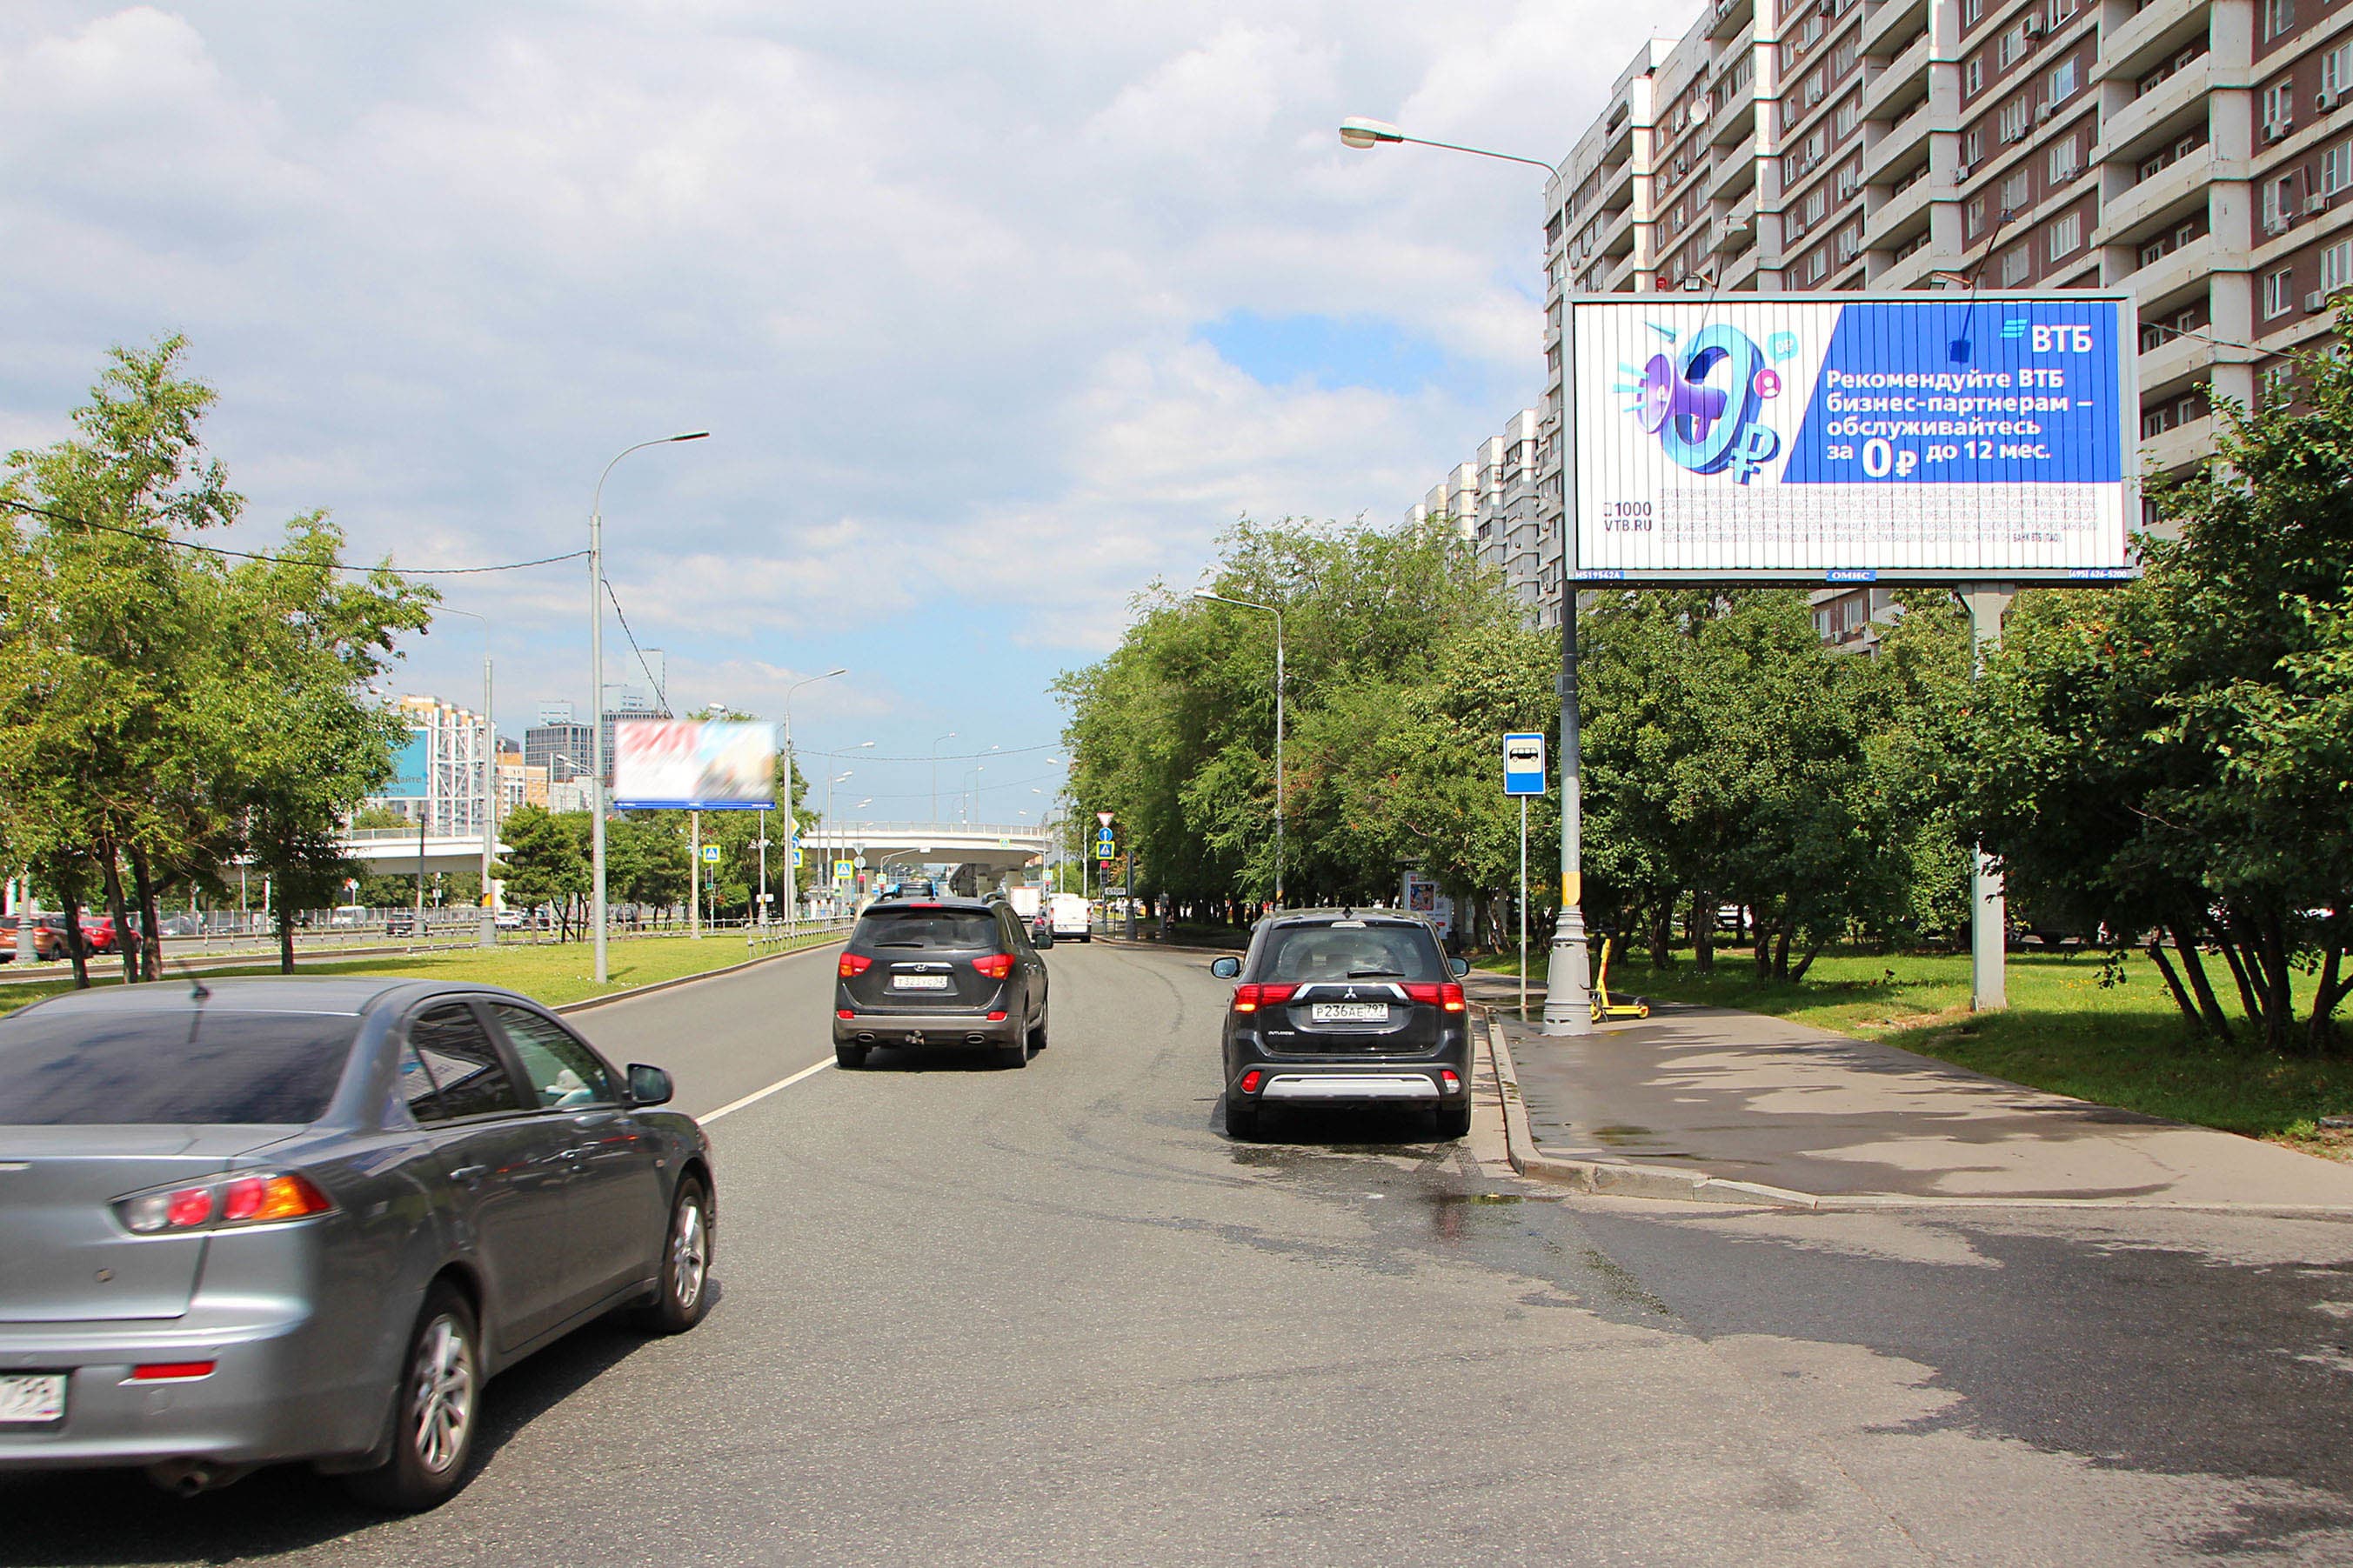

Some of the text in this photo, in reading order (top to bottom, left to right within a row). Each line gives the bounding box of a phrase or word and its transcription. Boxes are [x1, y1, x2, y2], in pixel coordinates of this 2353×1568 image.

[2031, 324, 2093, 353] ВТБ
[1826, 369, 2065, 393] Рекомендуйте ВТБ
[1826, 392, 2069, 417] бизнес-партнерам
[1826, 417, 2042, 440] обслуживайтесь
[1826, 445, 1854, 460] за
[1926, 444, 1958, 464] до
[1963, 441, 1993, 460] 12
[1999, 444, 2052, 460] мес.
[1614, 502, 1652, 517] 1000
[1604, 519, 1653, 532] VTB.RU
[2089, 570, 2127, 578] 626-5200
